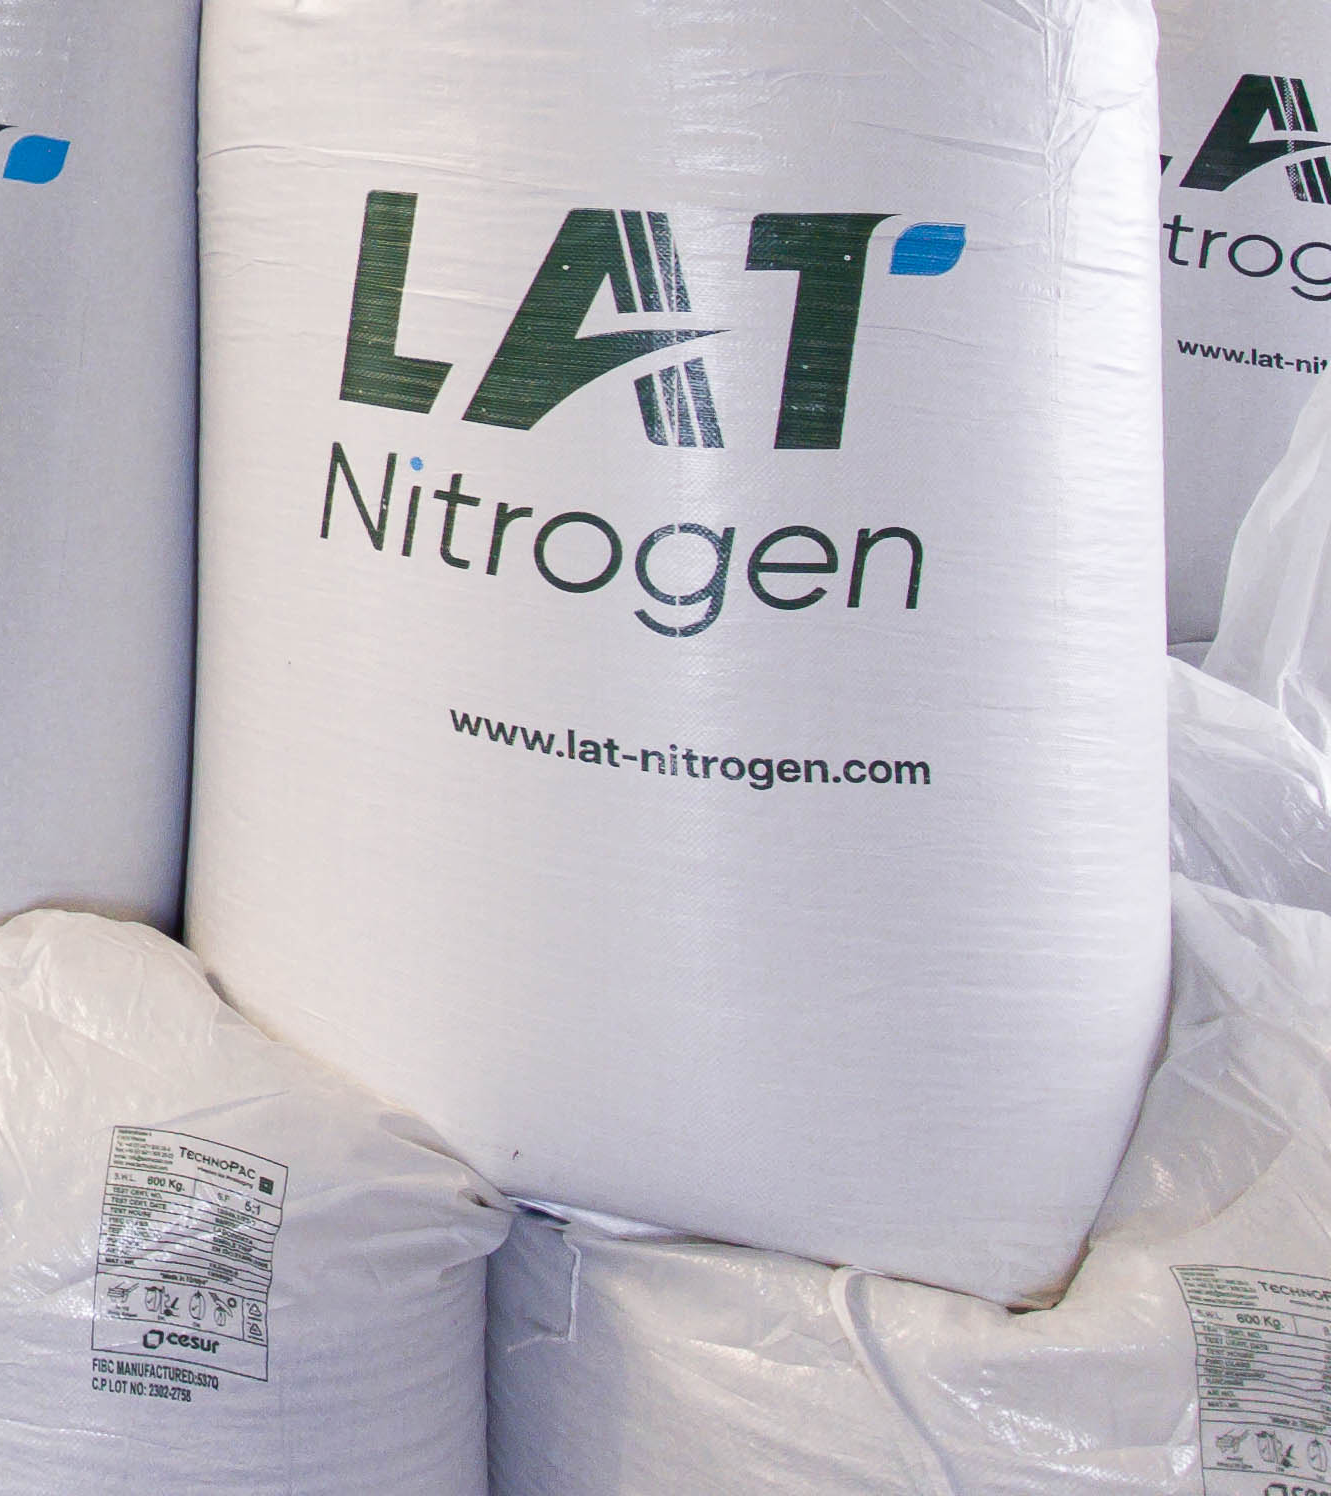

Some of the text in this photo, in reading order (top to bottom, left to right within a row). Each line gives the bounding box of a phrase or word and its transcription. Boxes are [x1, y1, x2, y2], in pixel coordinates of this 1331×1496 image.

[339, 189, 903, 450] LAT
[320, 441, 925, 638] Nitrogen
[449, 708, 932, 791] www.lat-nitrogen.com
[92, 1357, 115, 1375] FIBC
[165, 1331, 221, 1355] cesur
[108, 1380, 127, 1394] LOT
